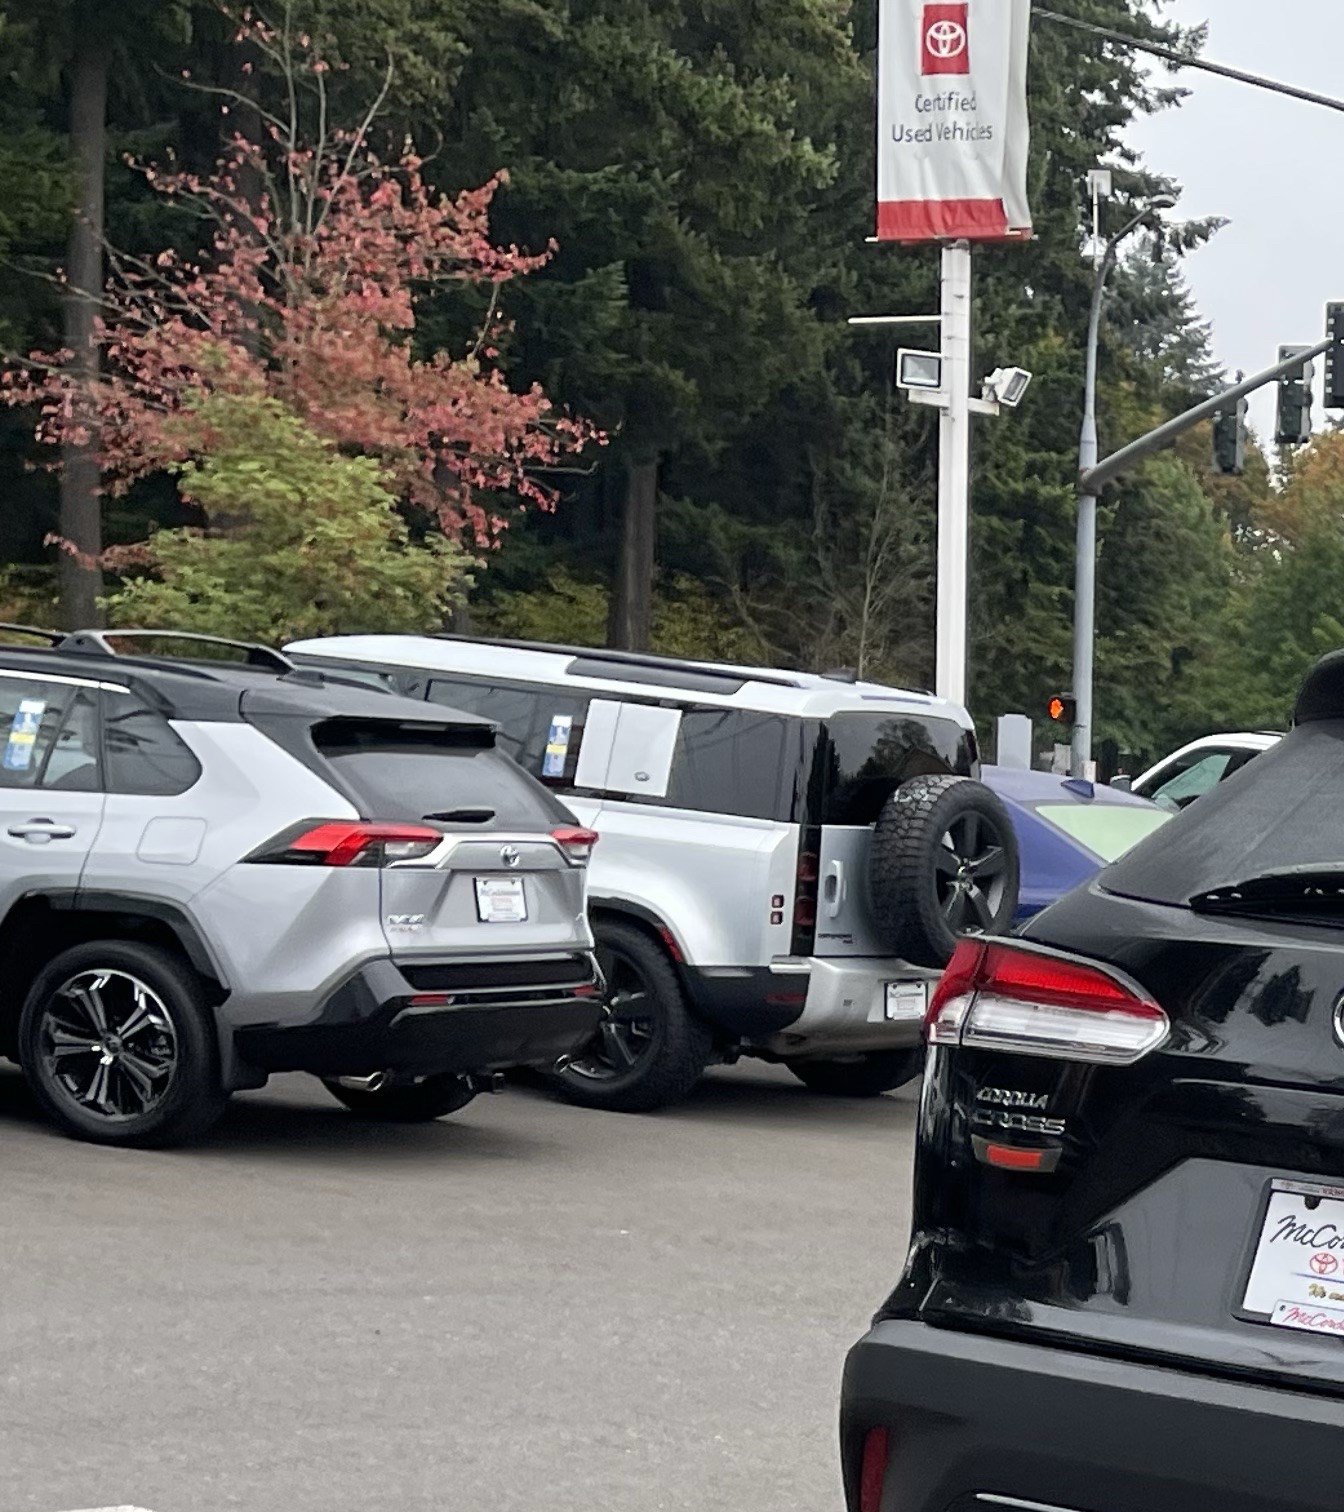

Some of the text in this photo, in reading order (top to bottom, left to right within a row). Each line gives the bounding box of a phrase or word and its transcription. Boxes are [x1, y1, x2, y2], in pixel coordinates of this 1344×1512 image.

[915, 91, 977, 112] Certified
[892, 121, 993, 142] Used Vehicles
